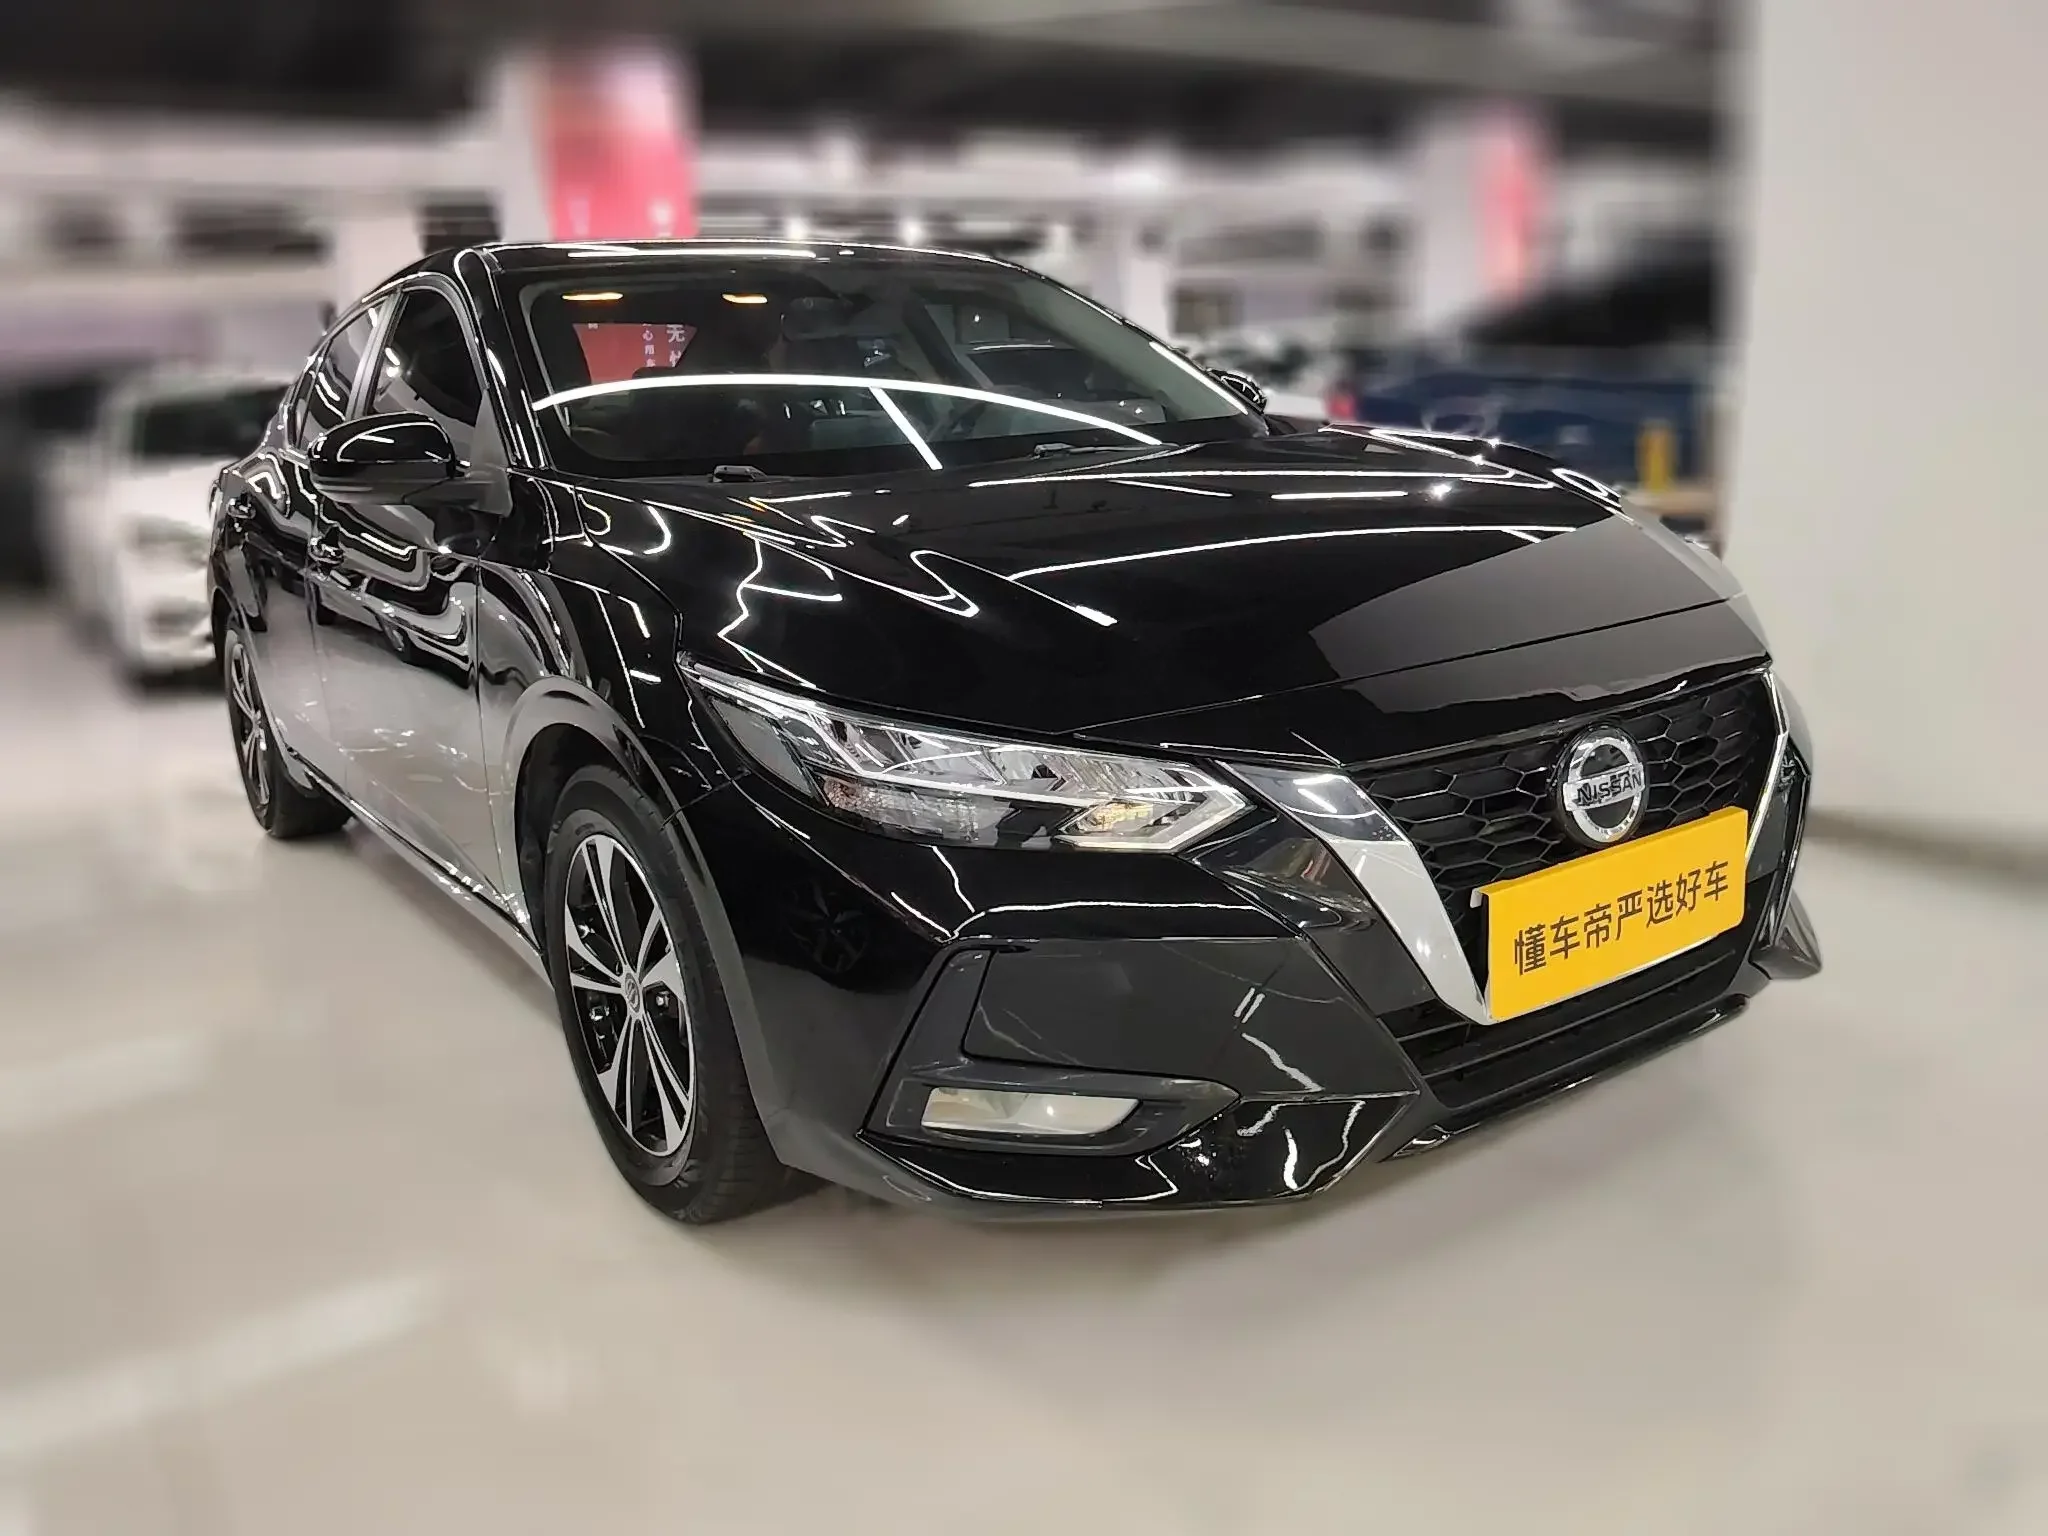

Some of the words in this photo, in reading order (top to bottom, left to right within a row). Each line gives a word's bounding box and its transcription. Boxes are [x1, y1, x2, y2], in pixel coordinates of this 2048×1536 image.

[1577, 770, 1642, 805] NISSAN
[1514, 861, 1729, 976] 懂车帝严选好车
